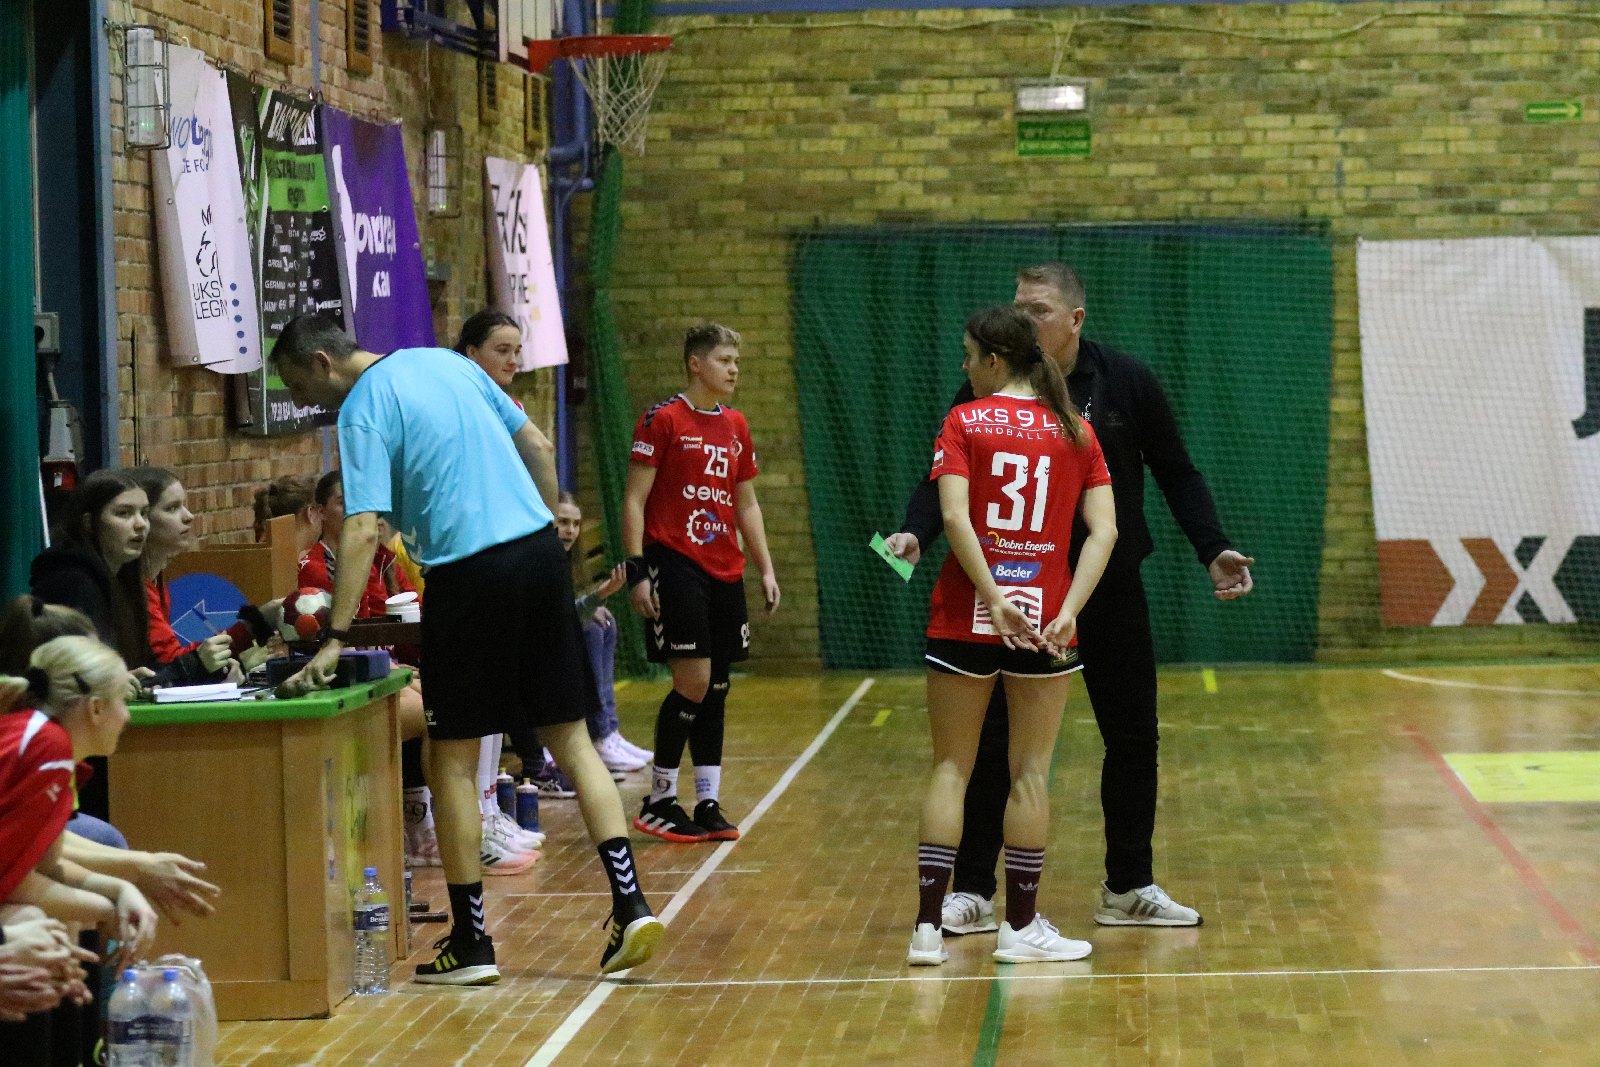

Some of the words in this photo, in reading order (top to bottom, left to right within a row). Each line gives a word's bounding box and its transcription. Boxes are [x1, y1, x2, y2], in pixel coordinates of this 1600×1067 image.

[195, 299, 229, 320] LEGN
[961, 408, 1008, 423] UKS
[1016, 409, 1034, 427] 9
[1042, 414, 1064, 428] L
[965, 426, 1043, 440] HANDBALL
[703, 444, 729, 479] 25
[986, 451, 1050, 532] 31
[999, 537, 1024, 550] Dobra
[1024, 540, 1056, 554] Energia
[995, 564, 1033, 579] Bacler
[670, 642, 696, 650] hummel
